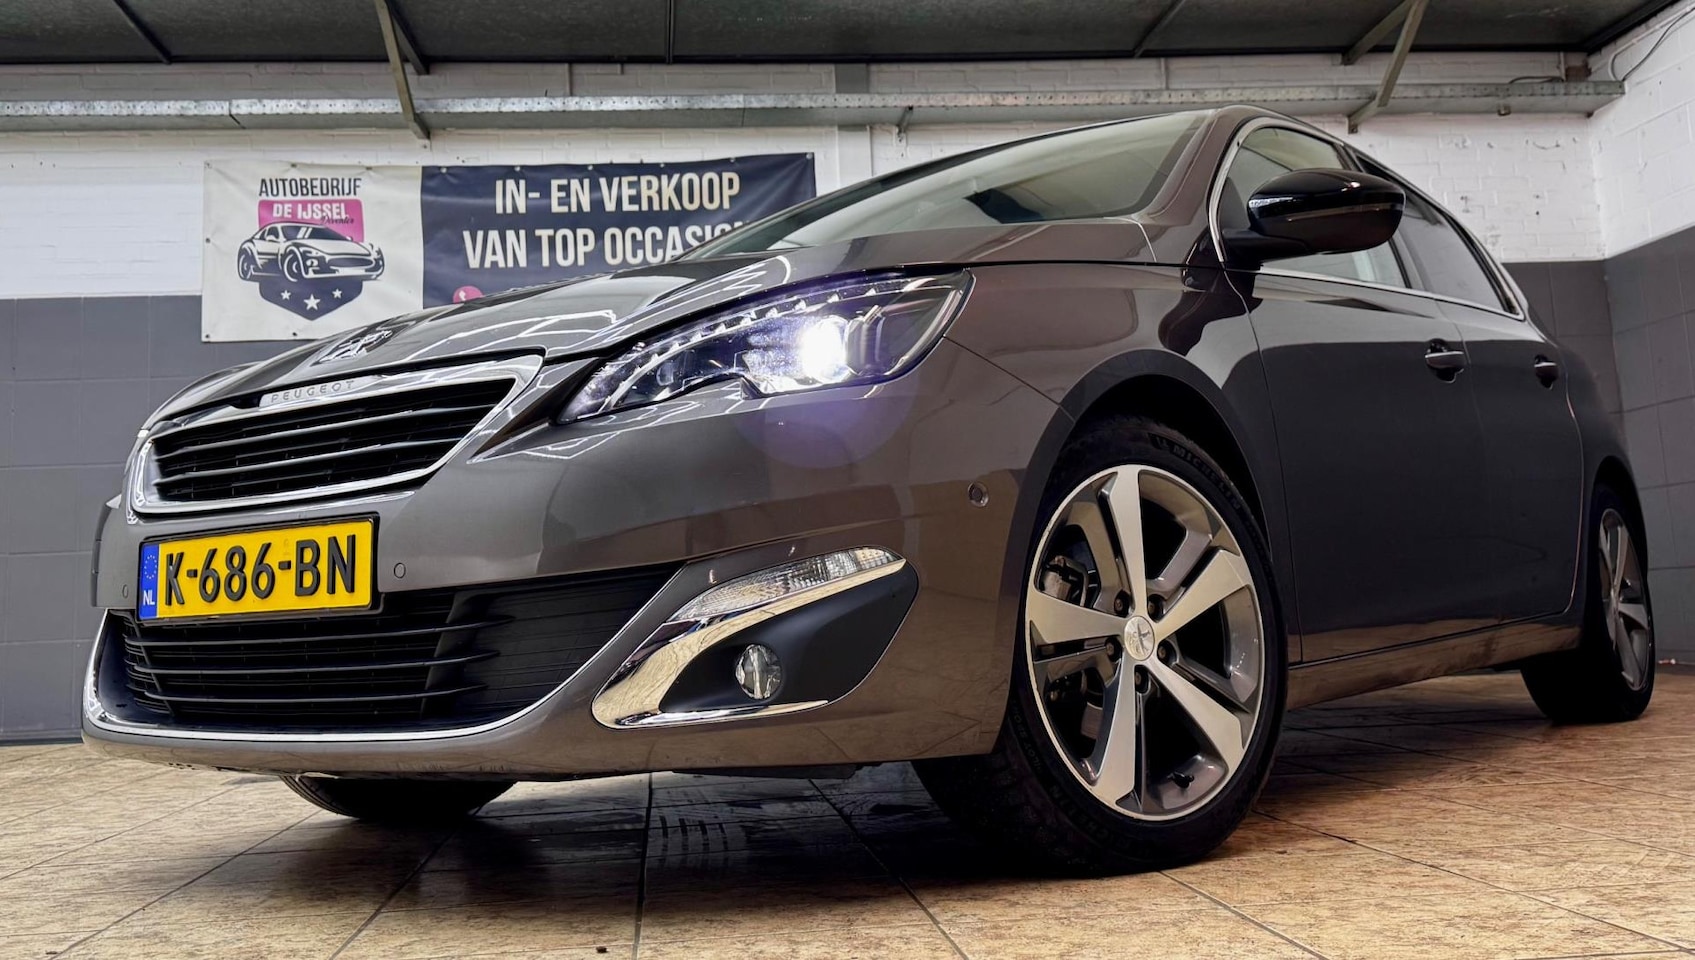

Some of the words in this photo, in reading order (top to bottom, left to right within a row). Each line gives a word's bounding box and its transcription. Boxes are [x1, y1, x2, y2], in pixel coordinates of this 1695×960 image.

[258, 177, 363, 198] AUTOBEDRIJF
[494, 179, 541, 214] IN-
[550, 177, 592, 213] EN
[600, 171, 741, 213] VERKOOP
[272, 203, 293, 219] DE
[297, 202, 349, 220] IJSSEL
[462, 230, 528, 270] VAN
[535, 228, 596, 267] TOP
[603, 220, 750, 266] OCCAS
[270, 379, 355, 403] PEUGEOT
[1172, 443, 1242, 511] MICHELIN
[164, 533, 357, 607] K-686-BN
[142, 590, 156, 607] NL
